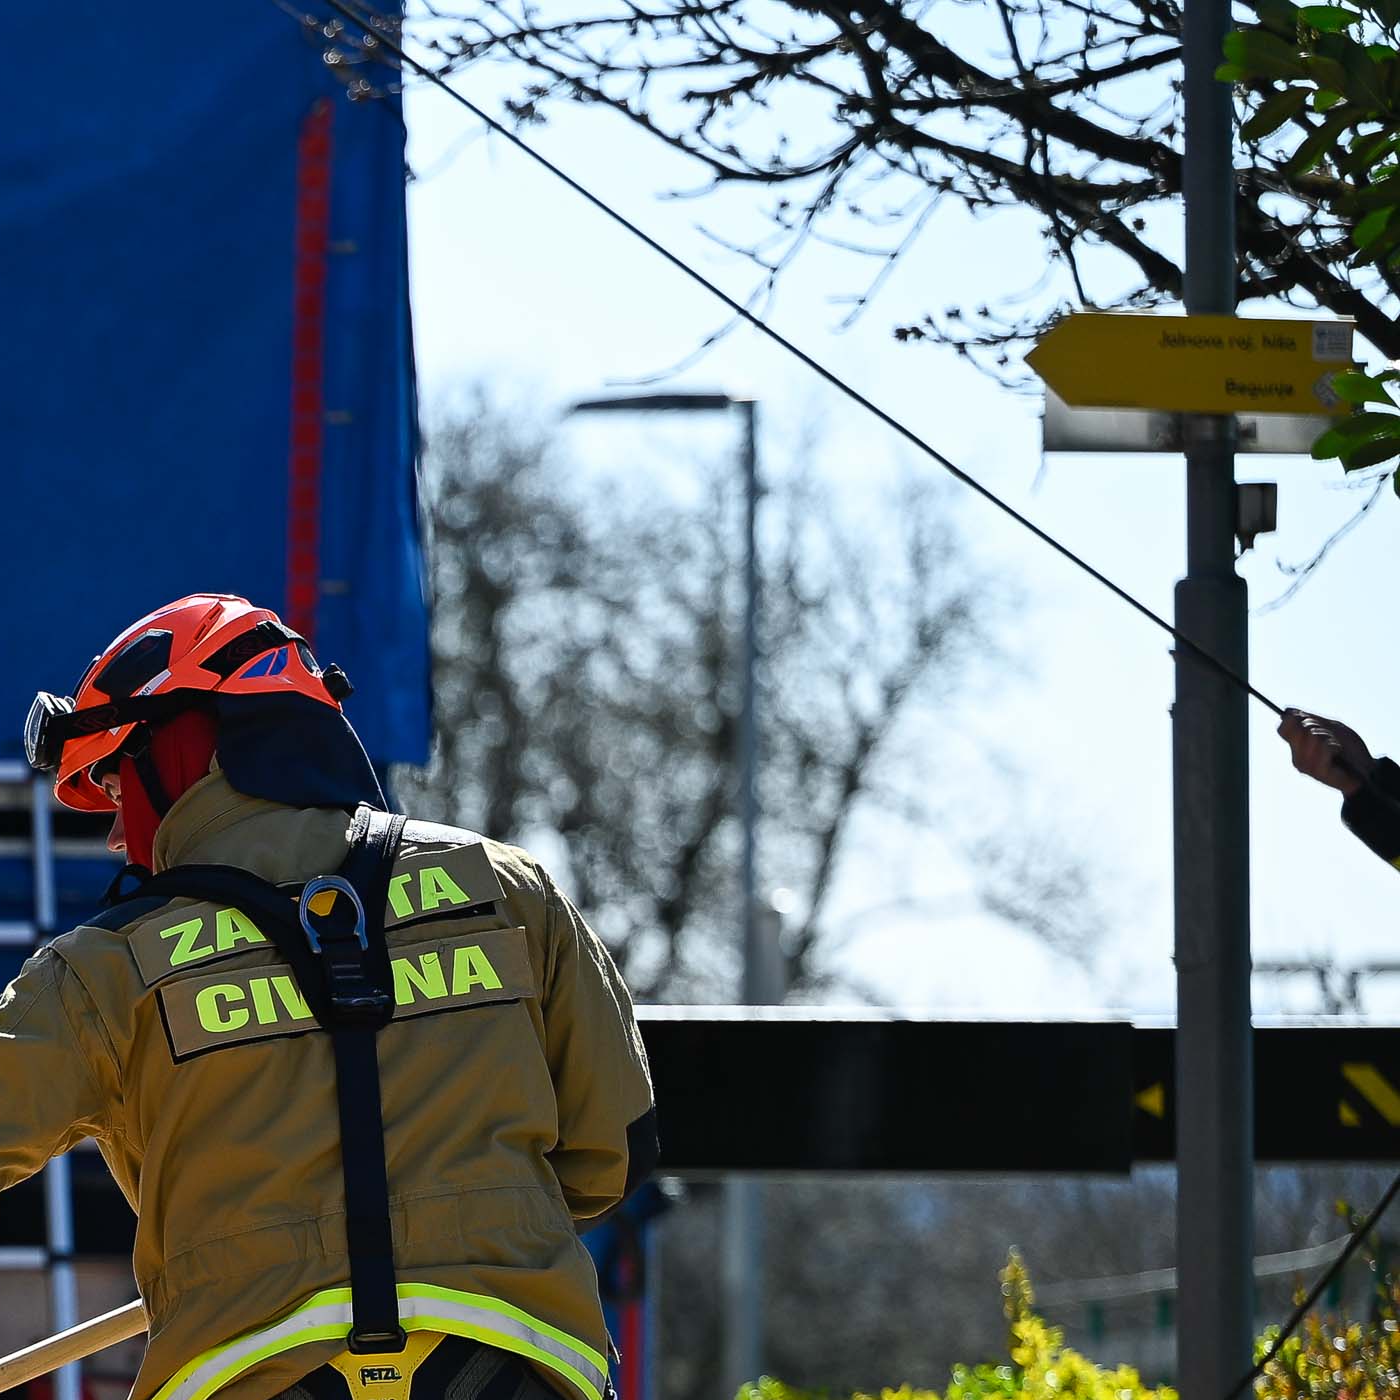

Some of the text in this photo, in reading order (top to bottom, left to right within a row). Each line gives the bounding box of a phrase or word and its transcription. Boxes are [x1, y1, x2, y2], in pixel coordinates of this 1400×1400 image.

[160, 867, 470, 966] ZATA
[196, 945, 503, 1033] CIVNA
[361, 1368, 402, 1386] PETZL
